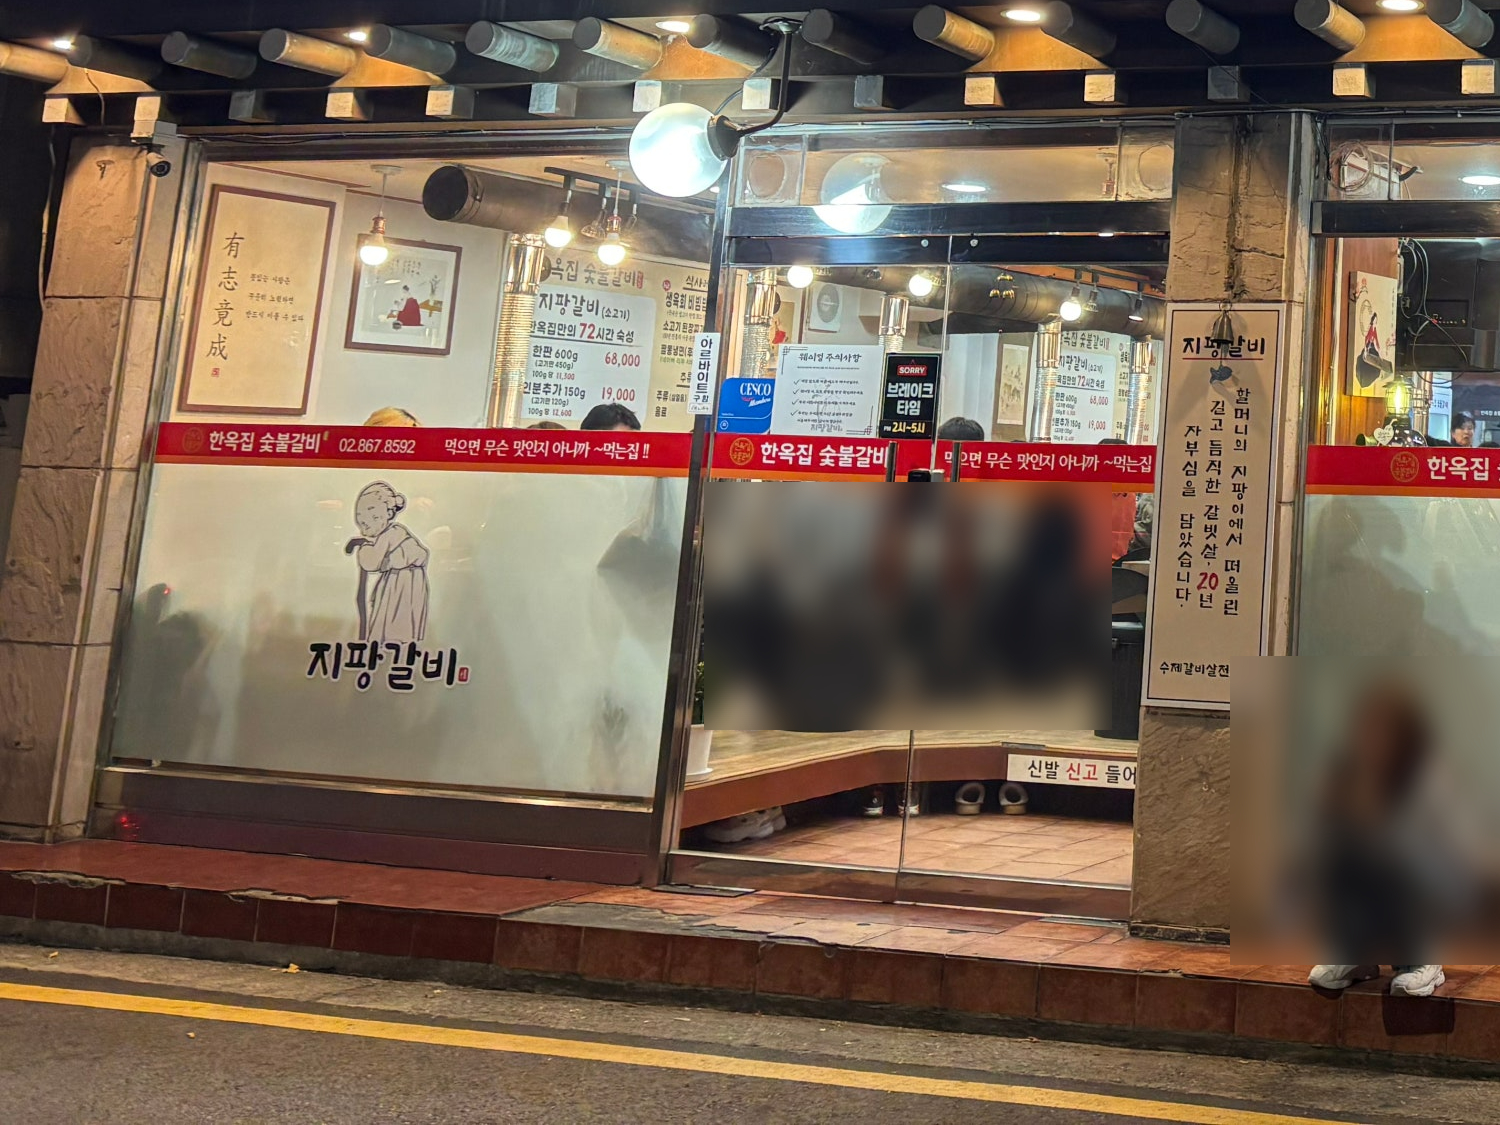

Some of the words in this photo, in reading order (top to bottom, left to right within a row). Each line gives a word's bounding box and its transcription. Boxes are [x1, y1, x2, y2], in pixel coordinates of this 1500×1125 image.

[550, 257, 578, 282] 옥집
[207, 232, 244, 360] 有志竟成
[538, 292, 599, 317] 지팡갈비
[601, 306, 630, 321] (소고기)
[580, 323, 614, 341] 72시간
[616, 328, 634, 343] 숙성
[663, 320, 681, 332] 소고기
[533, 345, 552, 358] 한판
[555, 349, 578, 362] 600g
[605, 352, 640, 367] 68,000
[695, 339, 712, 393] 아르바이트
[523, 382, 562, 396] 인분추가
[564, 386, 586, 400] 150g
[602, 387, 635, 401] 19,000
[740, 383, 771, 396] CESCO
[887, 383, 934, 398] 브레이크
[897, 400, 921, 415] 타임
[1210, 400, 1225, 431] 길고
[1233, 387, 1251, 452] 할머니의
[892, 422, 925, 433] 2시~5시
[209, 432, 254, 452] 한옥집
[259, 432, 321, 453] 숯불갈비
[339, 438, 416, 454] 02.867.8592
[444, 439, 481, 455] 먹으면
[484, 440, 509, 456] 무슨
[513, 440, 548, 457] 맛인지
[552, 441, 591, 458] 아니까
[761, 442, 813, 466] 한옥집
[819, 445, 888, 468] 숯불갈비
[986, 453, 1013, 469] 무슨
[1017, 453, 1055, 470] 맛인지
[1059, 454, 1100, 471] 아니까
[1182, 425, 1201, 497] 자부심을
[1205, 440, 1222, 494] 듬직한
[1427, 456, 1490, 481] 한옥집
[1226, 466, 1248, 546] 지팡이에서
[1197, 572, 1218, 609] 20년
[1224, 559, 1240, 616] 떠올린
[307, 641, 457, 692] 지팡갈비
[1159, 661, 1230, 677] 수제갈비살전
[1028, 760, 1060, 780] 신발
[1066, 762, 1098, 781] 신고
[1105, 765, 1137, 785] 들어
